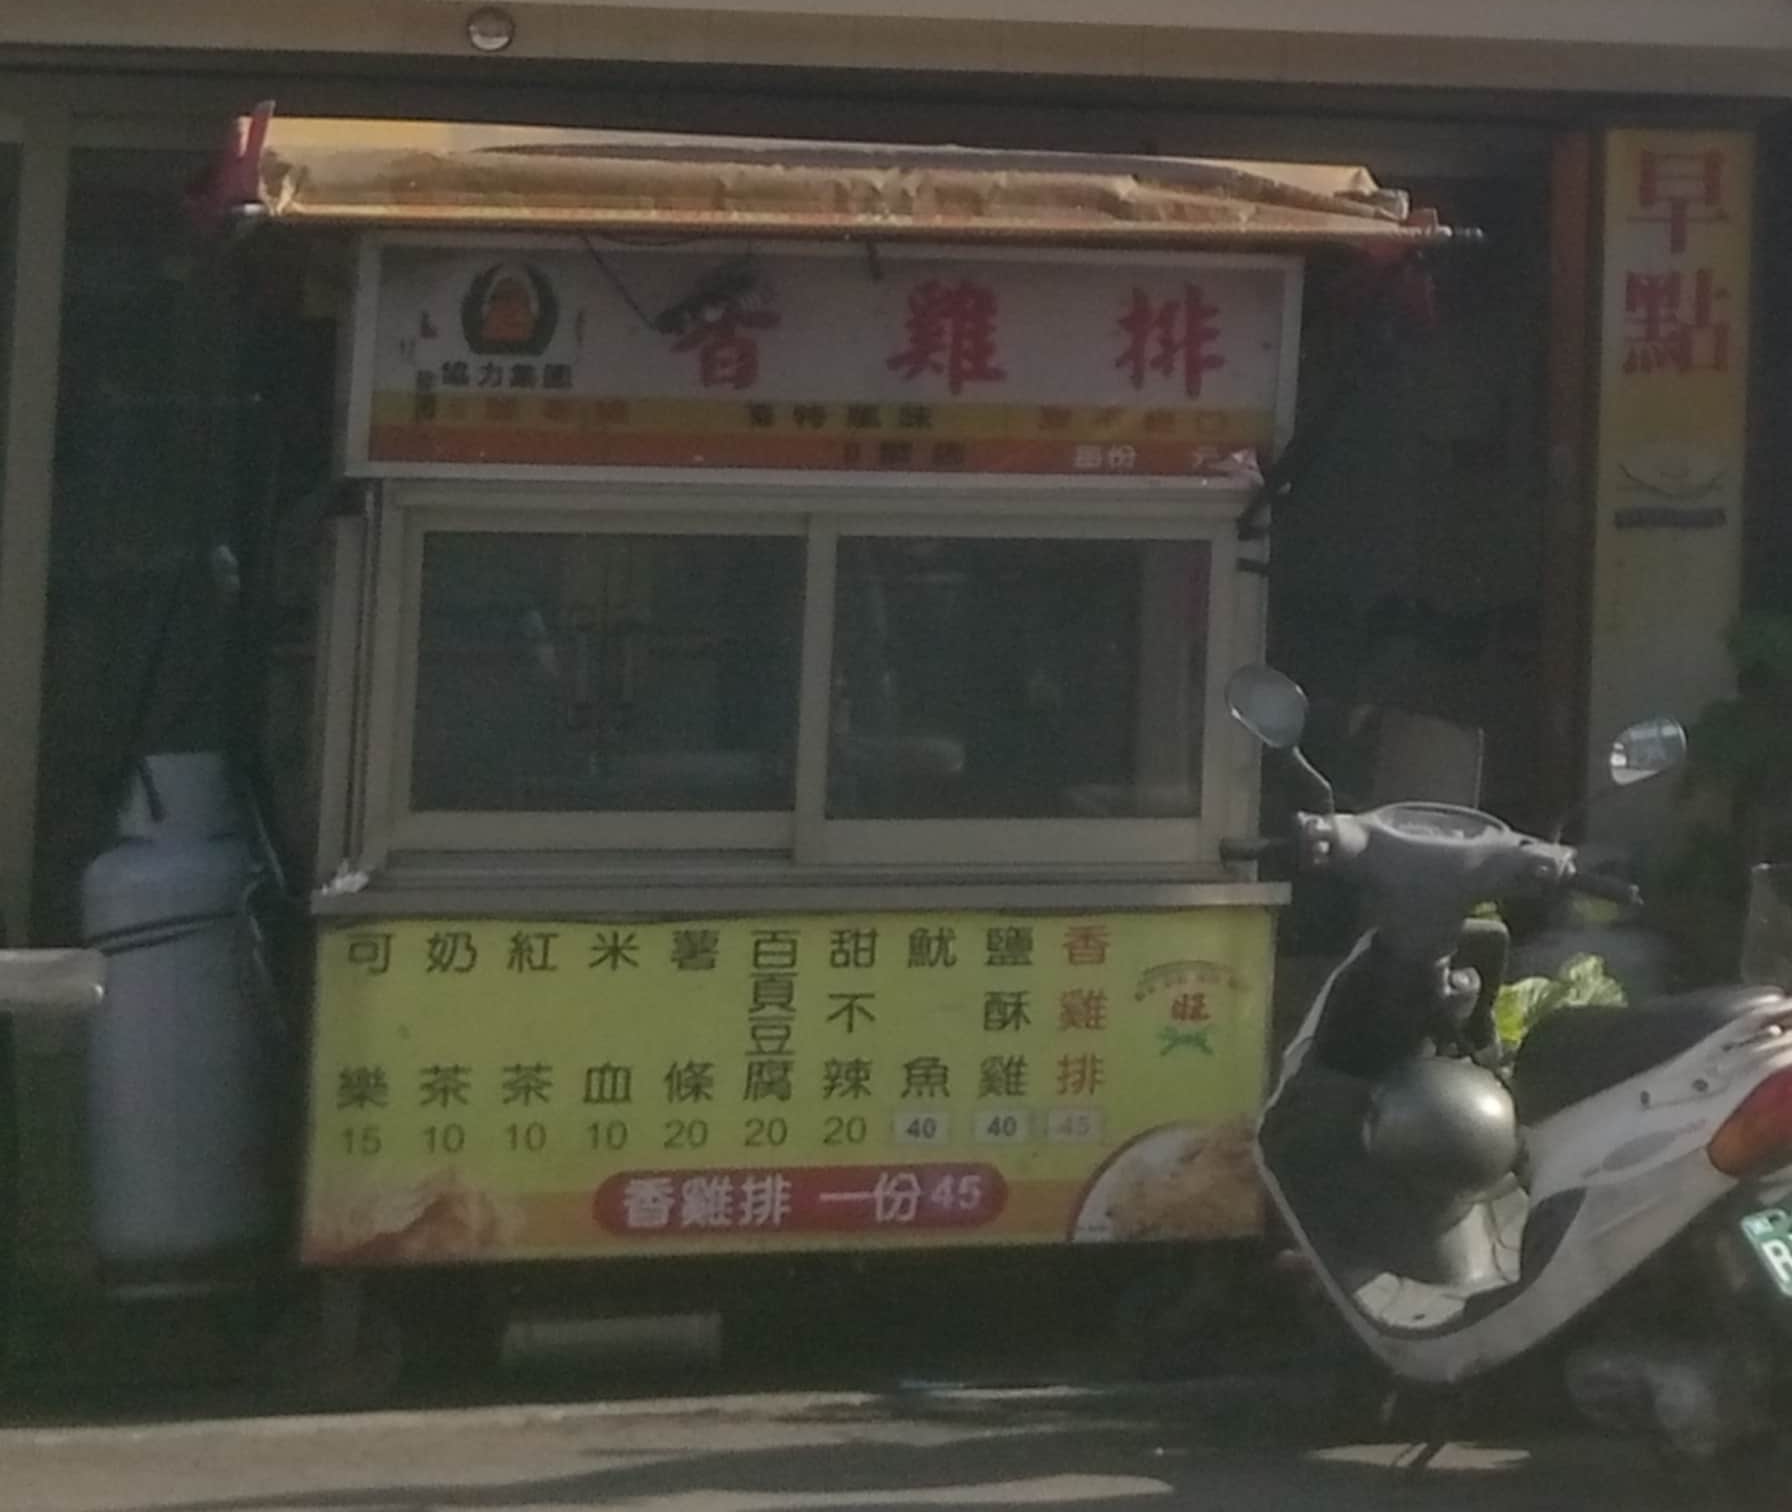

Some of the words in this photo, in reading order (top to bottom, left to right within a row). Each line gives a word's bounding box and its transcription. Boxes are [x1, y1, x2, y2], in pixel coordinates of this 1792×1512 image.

[670, 274, 1226, 396] 香雞排
[1623, 149, 1731, 374] 早點
[336, 932, 395, 1110] 可樂
[419, 931, 478, 1108] 奶茶
[502, 929, 559, 1108] 紅茶
[582, 931, 640, 1105] 米血
[662, 929, 720, 1104] 薯條
[822, 928, 878, 1100] 甜不辣
[901, 928, 958, 1099] 魷魚
[977, 926, 1035, 1099] 鹽酥雞
[1055, 925, 1111, 1097] 香雞排
[341, 1126, 382, 1156] 15
[423, 1123, 465, 1154] 10
[505, 1122, 547, 1152] 10
[587, 1120, 628, 1150] 10
[663, 1119, 709, 1149] 20
[744, 1117, 788, 1148] 20
[822, 1116, 867, 1145] 20
[906, 1118, 937, 1138] 40
[986, 1116, 1017, 1137] 40
[1056, 1115, 1090, 1137] 45
[623, 1172, 792, 1228] 香雞排
